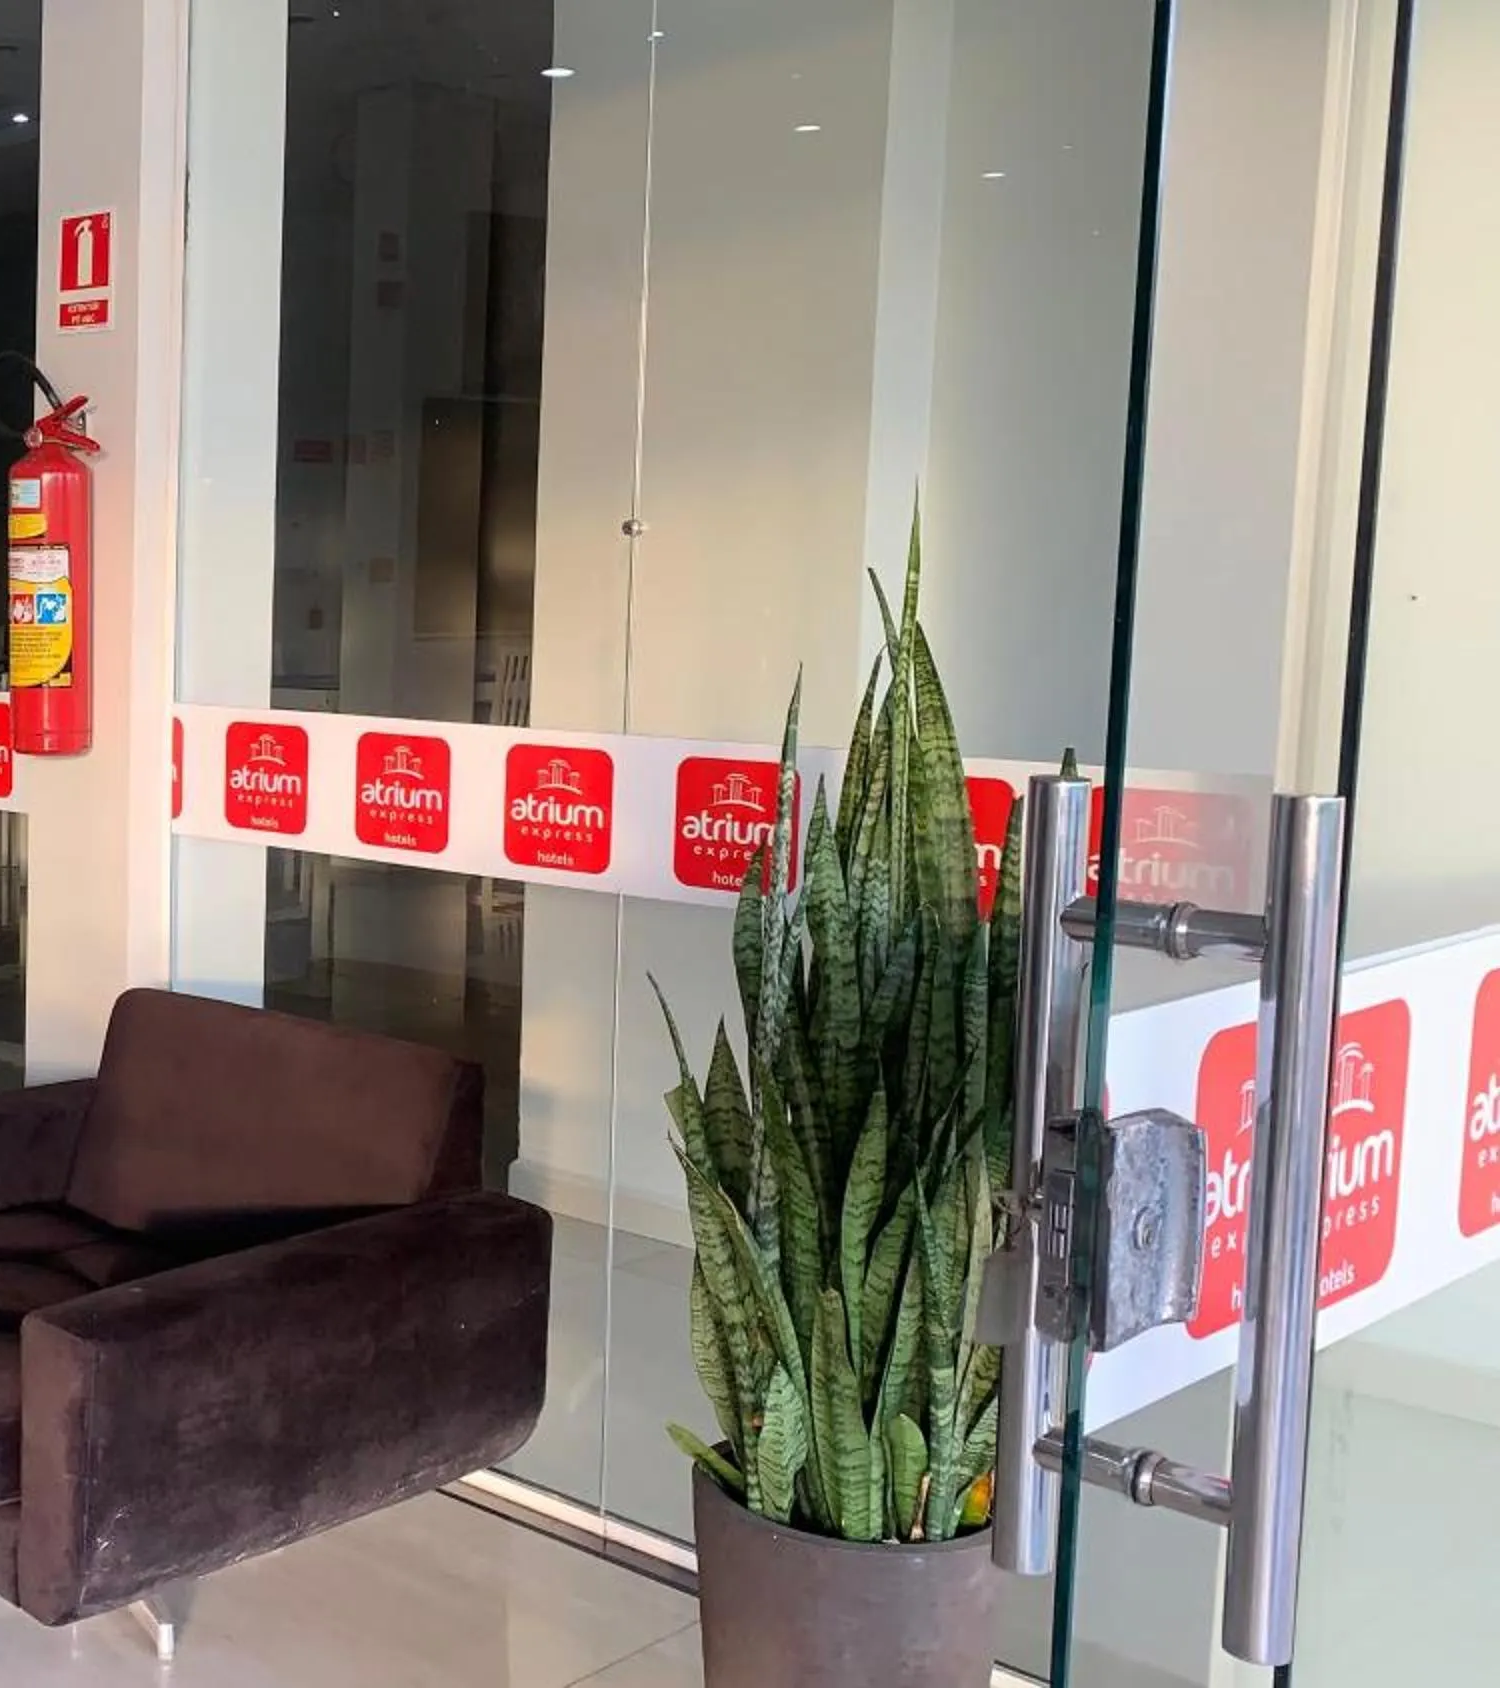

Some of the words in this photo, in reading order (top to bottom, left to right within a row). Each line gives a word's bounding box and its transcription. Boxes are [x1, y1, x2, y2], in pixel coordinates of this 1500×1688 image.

[230, 765, 301, 795] atrium
[237, 793, 293, 809] express
[360, 778, 443, 811] atrium
[369, 808, 433, 825] express
[511, 792, 604, 829] atrium
[384, 832, 417, 846] hotels
[521, 826, 592, 844] express
[537, 850, 575, 867] hotels
[693, 844, 773, 861] expre
[712, 870, 743, 886] hote
[1319, 1258, 1356, 1297] otels
